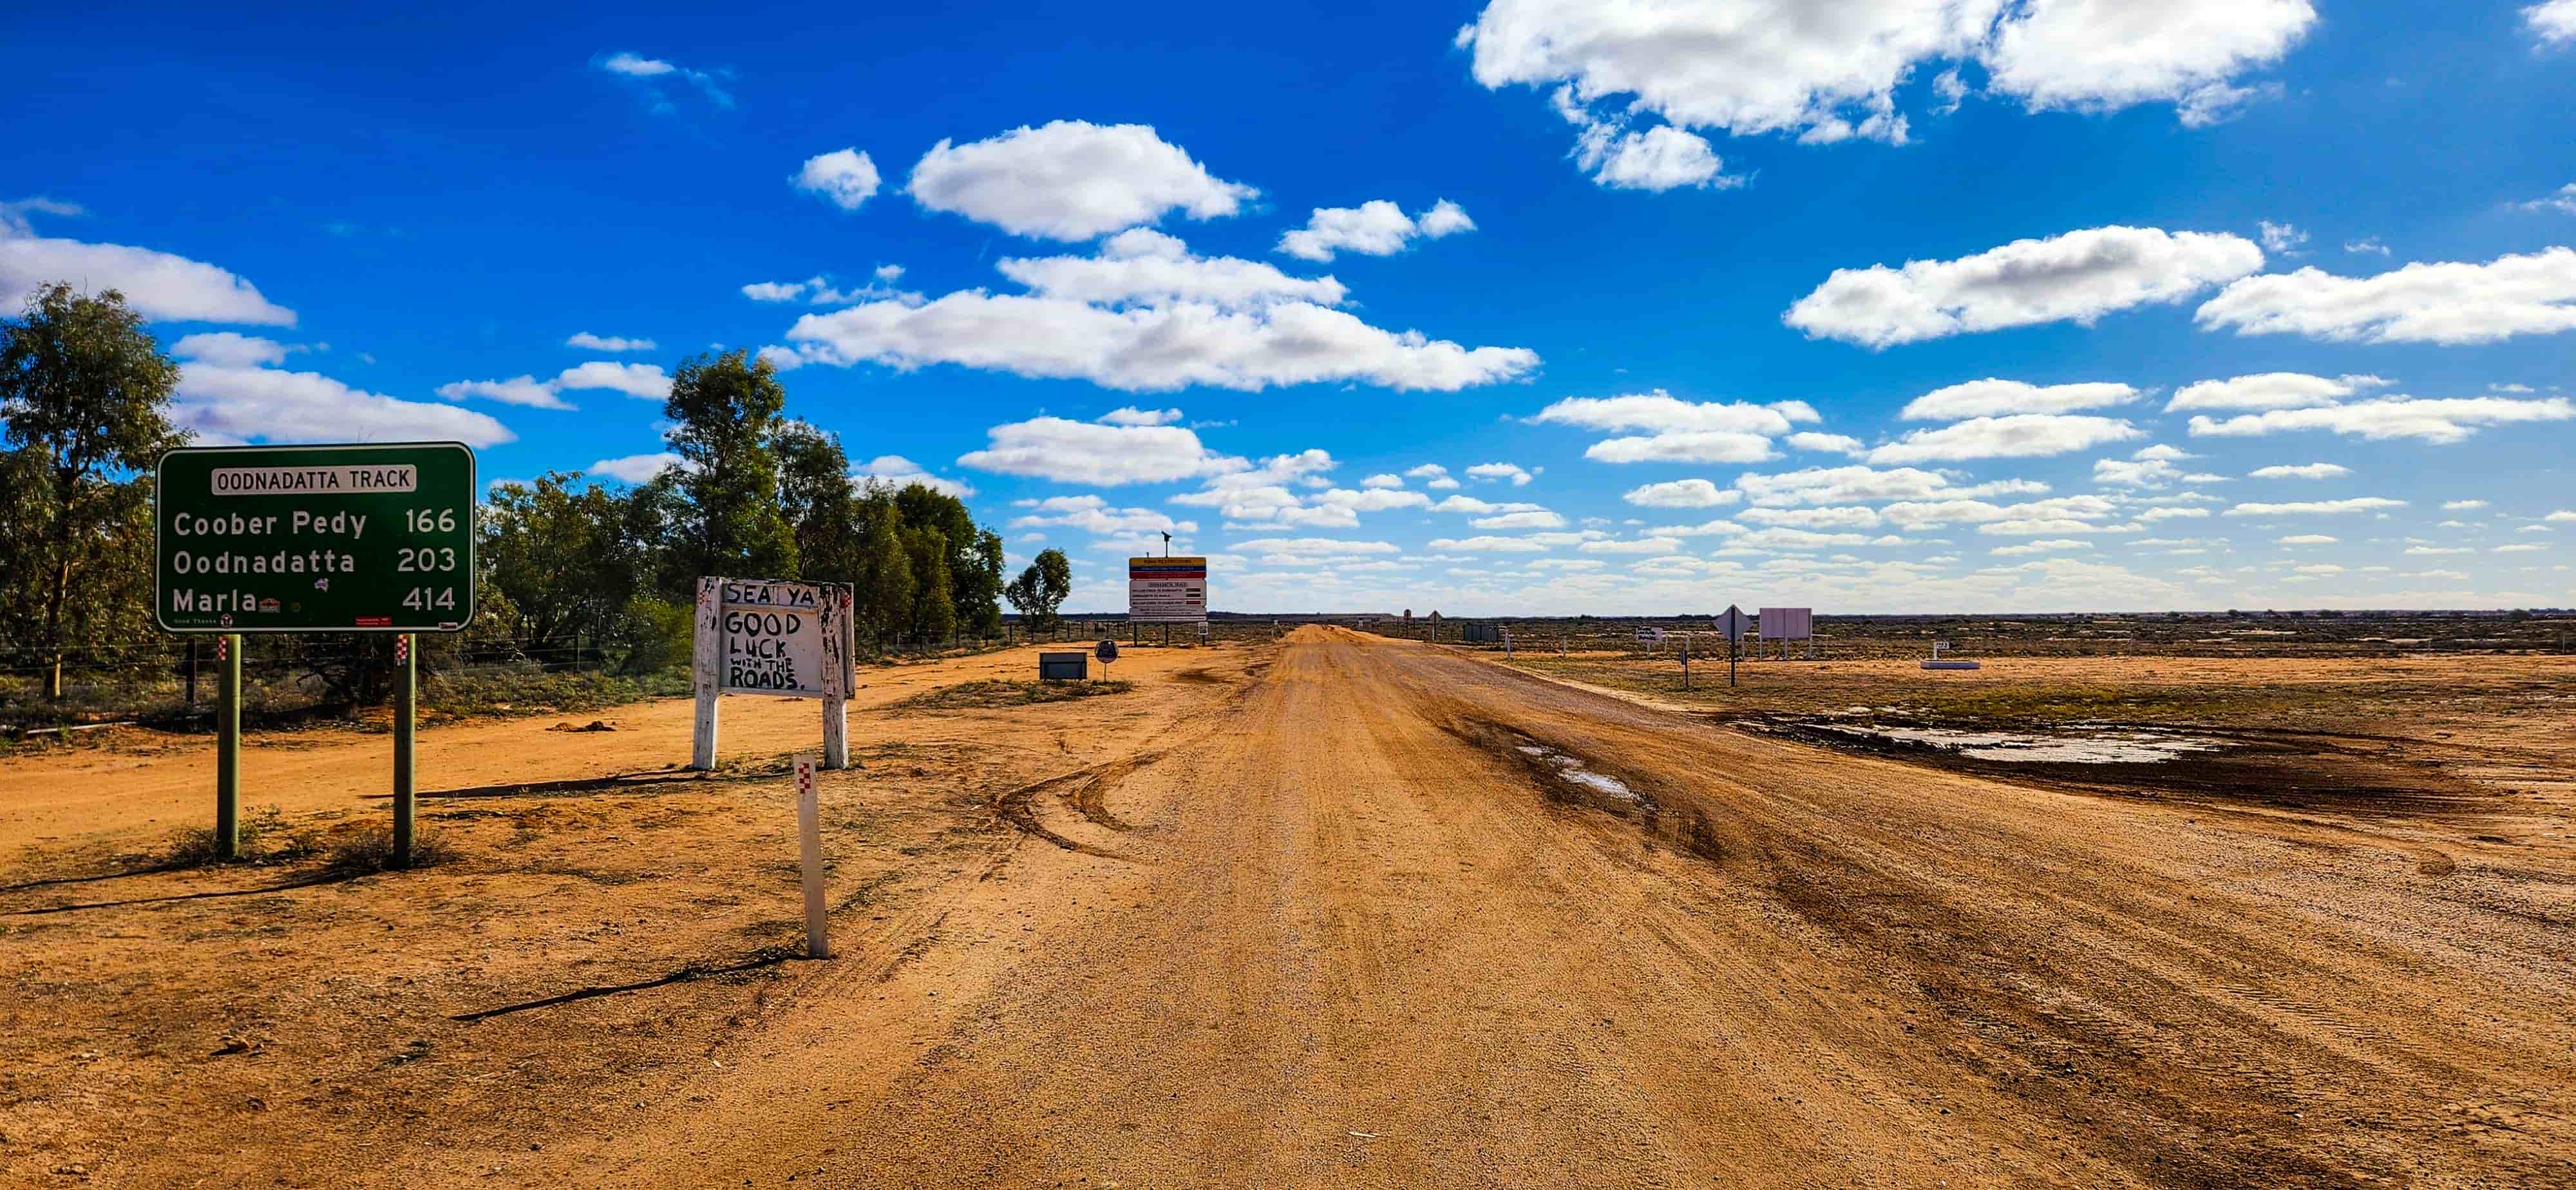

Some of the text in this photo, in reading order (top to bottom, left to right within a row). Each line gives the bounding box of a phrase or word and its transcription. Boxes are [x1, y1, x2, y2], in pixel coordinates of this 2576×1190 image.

[217, 469, 411, 491] OODNADATTA TRACK
[174, 508, 456, 539] Coober Pedy 166
[173, 547, 456, 574] Oodnadatta 203
[172, 588, 257, 612] Marla
[402, 587, 456, 611] 414
[726, 582, 815, 606] SEA YA
[725, 611, 802, 638] GOOD
[730, 636, 787, 659] LUCK
[730, 657, 795, 673] WITH THE
[730, 666, 806, 690] ROADS.
